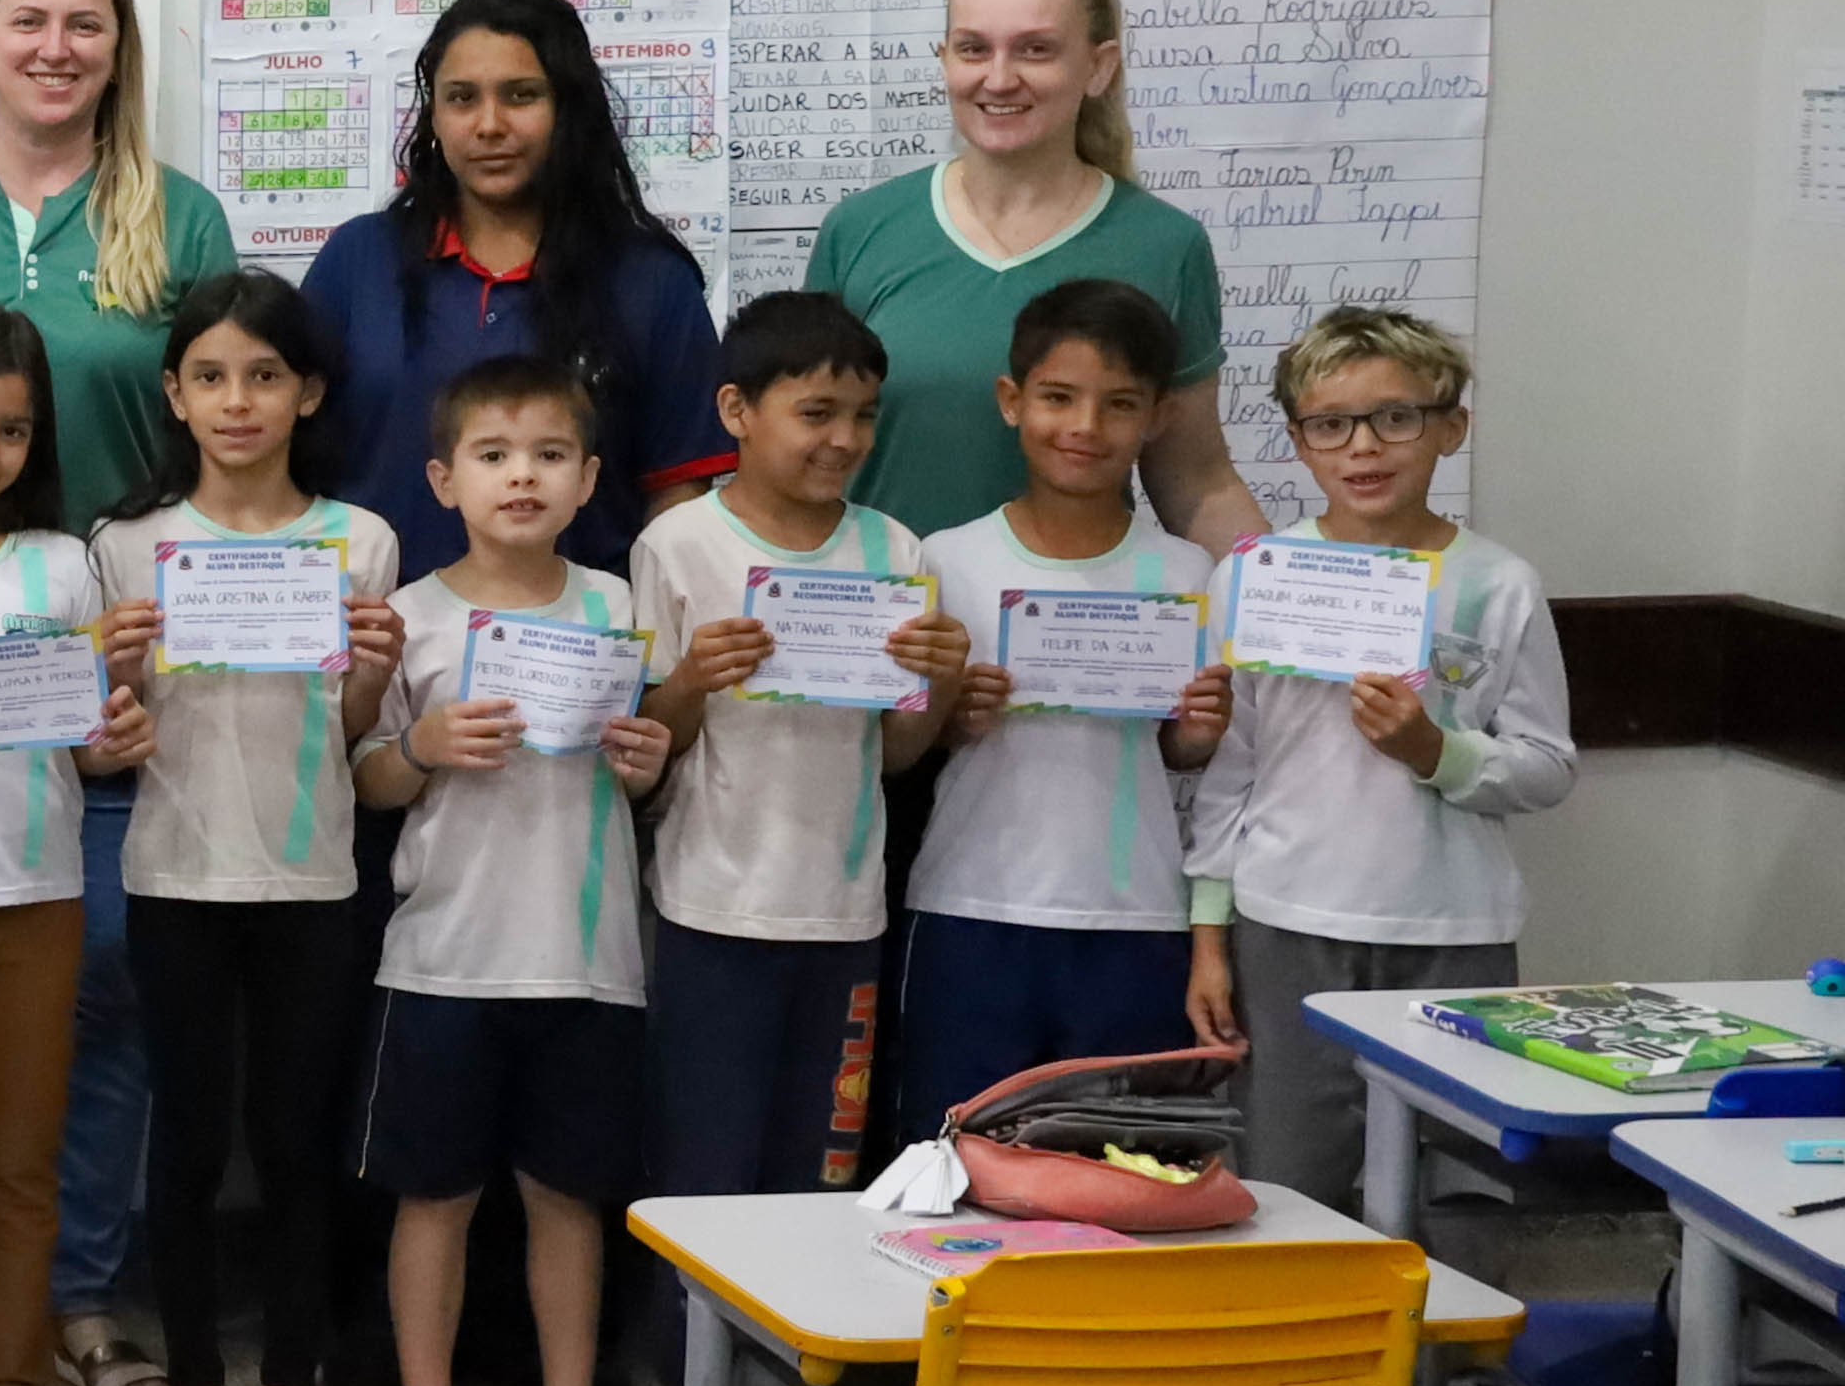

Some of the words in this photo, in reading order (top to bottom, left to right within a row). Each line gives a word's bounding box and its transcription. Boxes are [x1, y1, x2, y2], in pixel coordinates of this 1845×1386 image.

[592, 43, 692, 58] SETEMBRO
[845, 44, 856, 60] A
[871, 42, 909, 60] SUA
[264, 55, 323, 69] JULHO
[1199, 66, 1311, 104] Cristina
[1331, 62, 1487, 117] Gonçalves
[827, 91, 867, 109] DOS
[730, 141, 803, 159] SABER
[826, 135, 935, 158] ESCUTAR.
[1218, 148, 1310, 187] Farias
[802, 188, 827, 203] AS
[252, 228, 333, 244] OUTUBR
[797, 237, 811, 247] Eu
